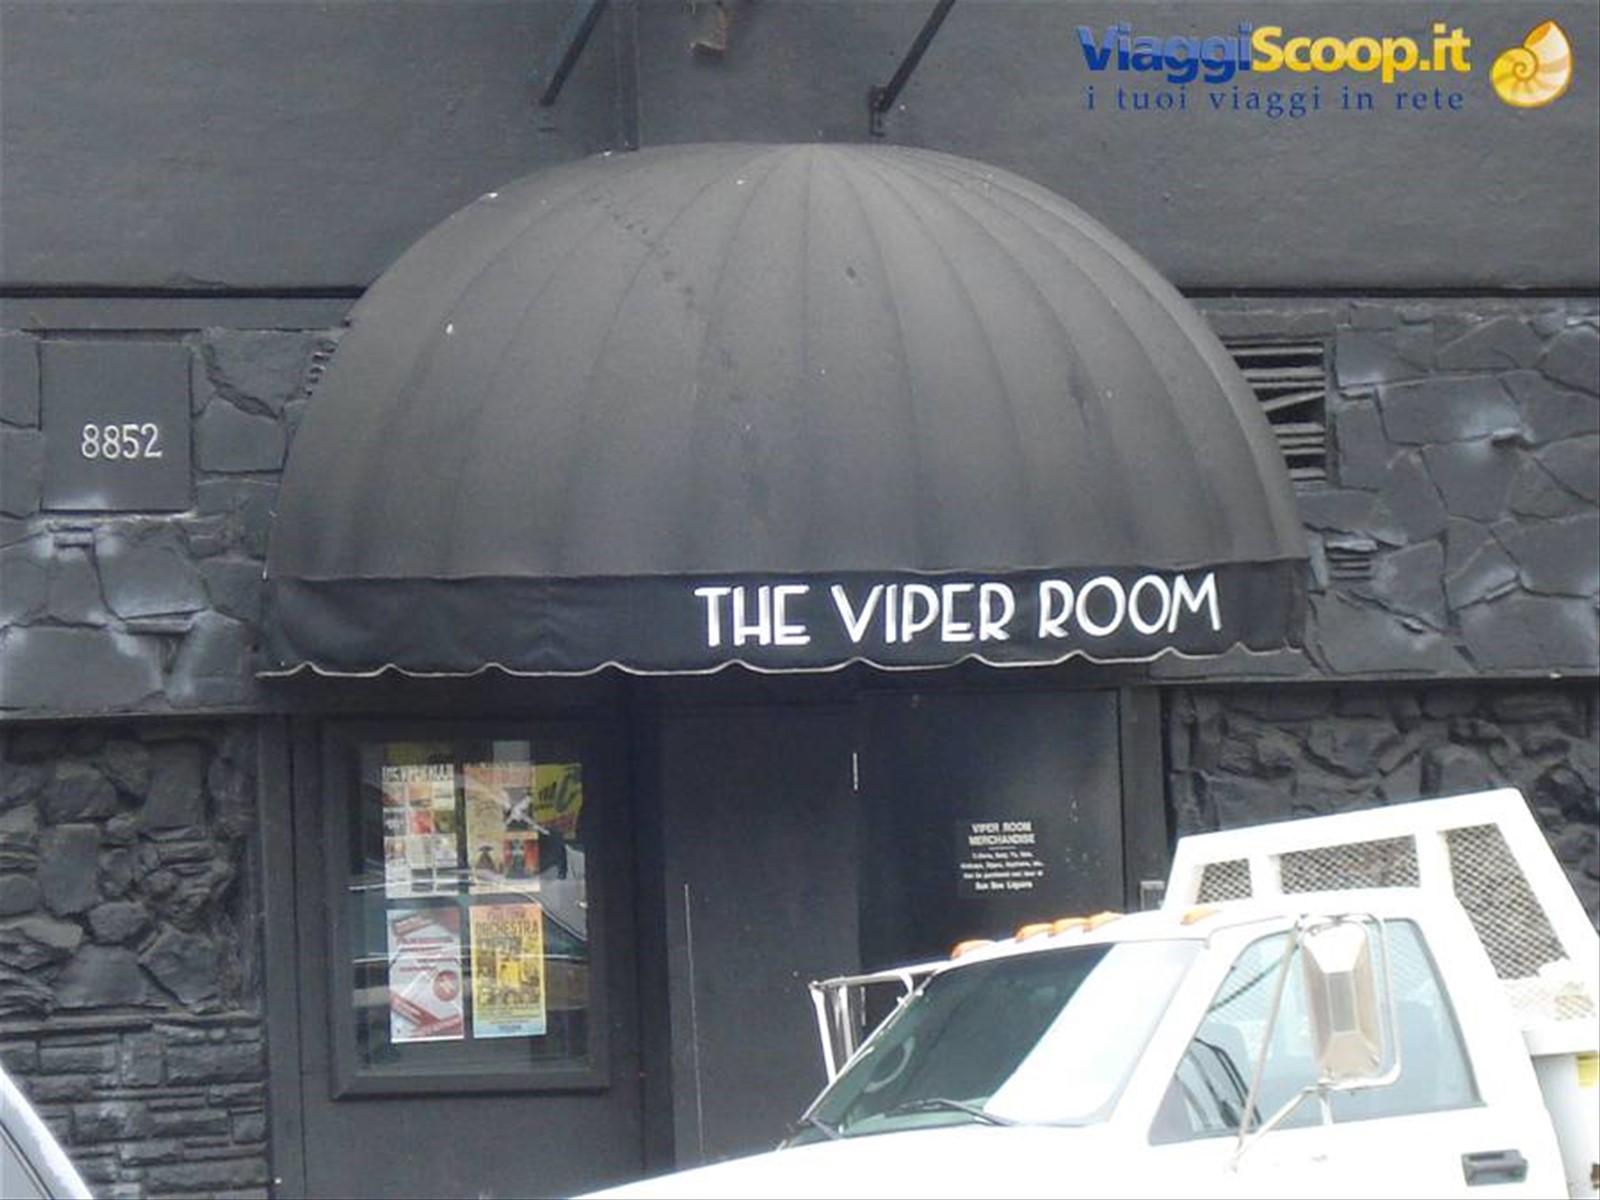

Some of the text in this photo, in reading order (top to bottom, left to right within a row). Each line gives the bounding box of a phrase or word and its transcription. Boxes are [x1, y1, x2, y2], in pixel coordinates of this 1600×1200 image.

[81, 423, 163, 459] 8852
[694, 573, 1222, 647] THE VIPER ROOM
